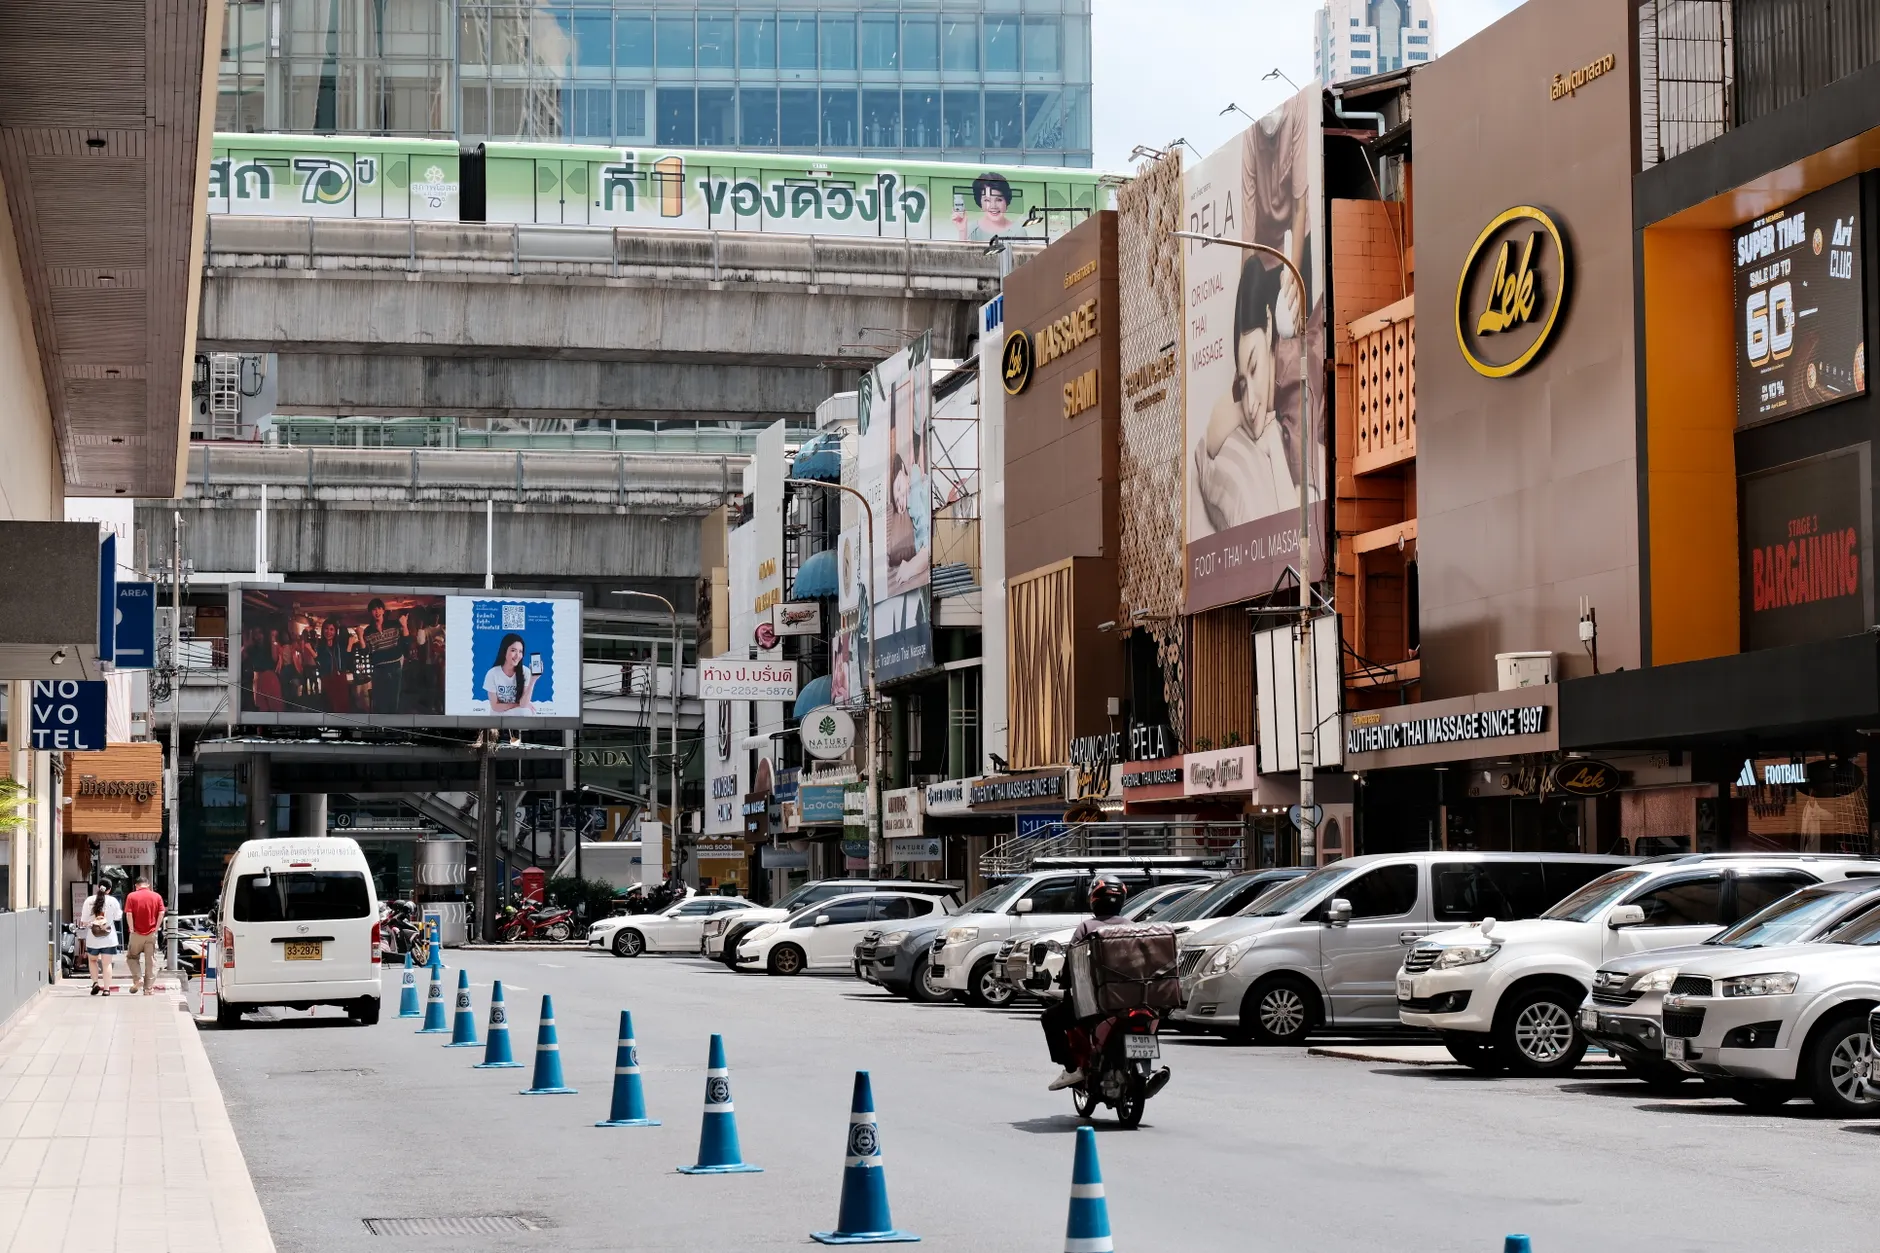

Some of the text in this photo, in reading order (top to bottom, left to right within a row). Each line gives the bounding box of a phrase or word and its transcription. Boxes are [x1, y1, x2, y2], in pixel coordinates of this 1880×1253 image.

[604, 152, 635, 211] ที่
[700, 172, 926, 224] ของดวงใจ
[1190, 189, 1235, 256] PELA
[1831, 216, 1855, 247] Ari
[1738, 212, 1806, 267] SUPER TIME
[1750, 258, 1791, 289] SALE UP TO
[1830, 250, 1853, 280] CLUB
[1191, 271, 1225, 307] ORIGINAL
[1476, 231, 1537, 336] Lek
[1035, 298, 1098, 369] MASSAGE
[1191, 313, 1207, 341] THAI
[1191, 338, 1224, 372] MASSAGE
[1063, 368, 1098, 419] SIAM
[1768, 380, 1785, 399] 10%
[1787, 514, 1818, 538] STAGE 3
[1194, 551, 1216, 580] FOOT
[1223, 543, 1243, 569] THAI
[1250, 539, 1266, 562] OIL
[1752, 526, 1859, 612] BARGAINING
[120, 589, 148, 597] AREA
[880, 650, 901, 668] Traditional
[900, 646, 910, 662] Thai
[910, 643, 927, 660] Massage
[704, 664, 792, 682] ห้าง ป.บรั่นดี
[33, 680, 79, 699] NO
[716, 686, 794, 696] 0-2252-5876
[33, 704, 79, 725] VO
[33, 728, 89, 750] TEL
[809, 737, 848, 746] NATURE
[1347, 706, 1543, 753] AUTHENTIC THAI MASSAGE SINCE 1997
[1141, 771, 1153, 785] THAI
[1153, 768, 1177, 783] MASSAGE
[1565, 767, 1606, 789] Lek
[1764, 763, 1806, 785] FOOTBALL
[80, 780, 158, 802] massage
[1006, 780, 1030, 799] MASSAGE
[1031, 777, 1047, 797] SINCE
[803, 802, 814, 810] La
[815, 801, 826, 809] Or
[107, 846, 148, 854] THAI THAI
